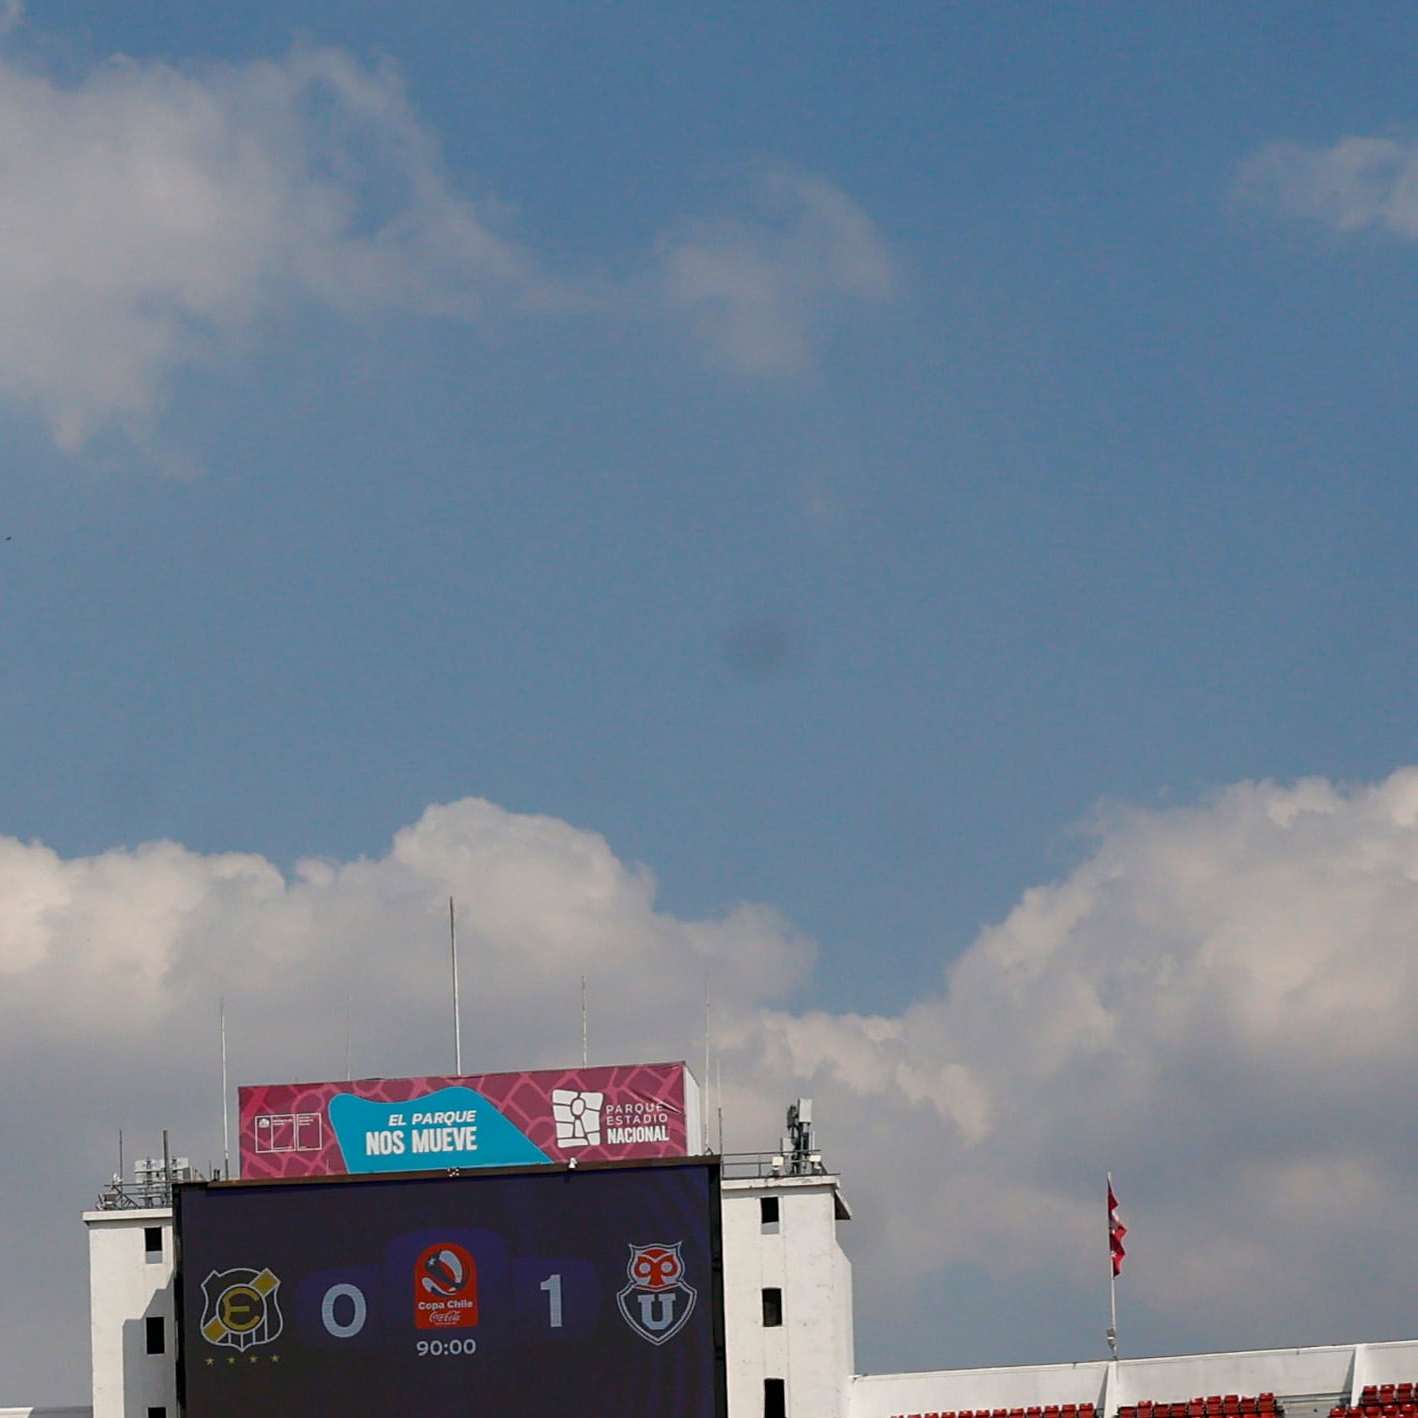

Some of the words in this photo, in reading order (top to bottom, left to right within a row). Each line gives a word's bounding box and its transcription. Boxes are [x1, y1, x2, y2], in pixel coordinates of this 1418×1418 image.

[606, 1103, 663, 1114] PARQUE
[388, 1113, 408, 1127] EL
[412, 1110, 477, 1125] PARQUE
[606, 1113, 669, 1126] ESTADIO
[366, 1130, 405, 1155] NOS
[411, 1126, 478, 1153] MUEVE
[607, 1125, 669, 1144] NACIONAL
[418, 1302, 445, 1311] Copa
[447, 1300, 474, 1309] Chile
[540, 1274, 562, 1328] 1
[321, 1283, 366, 1338] 0
[416, 1339, 476, 1356] 90:00
